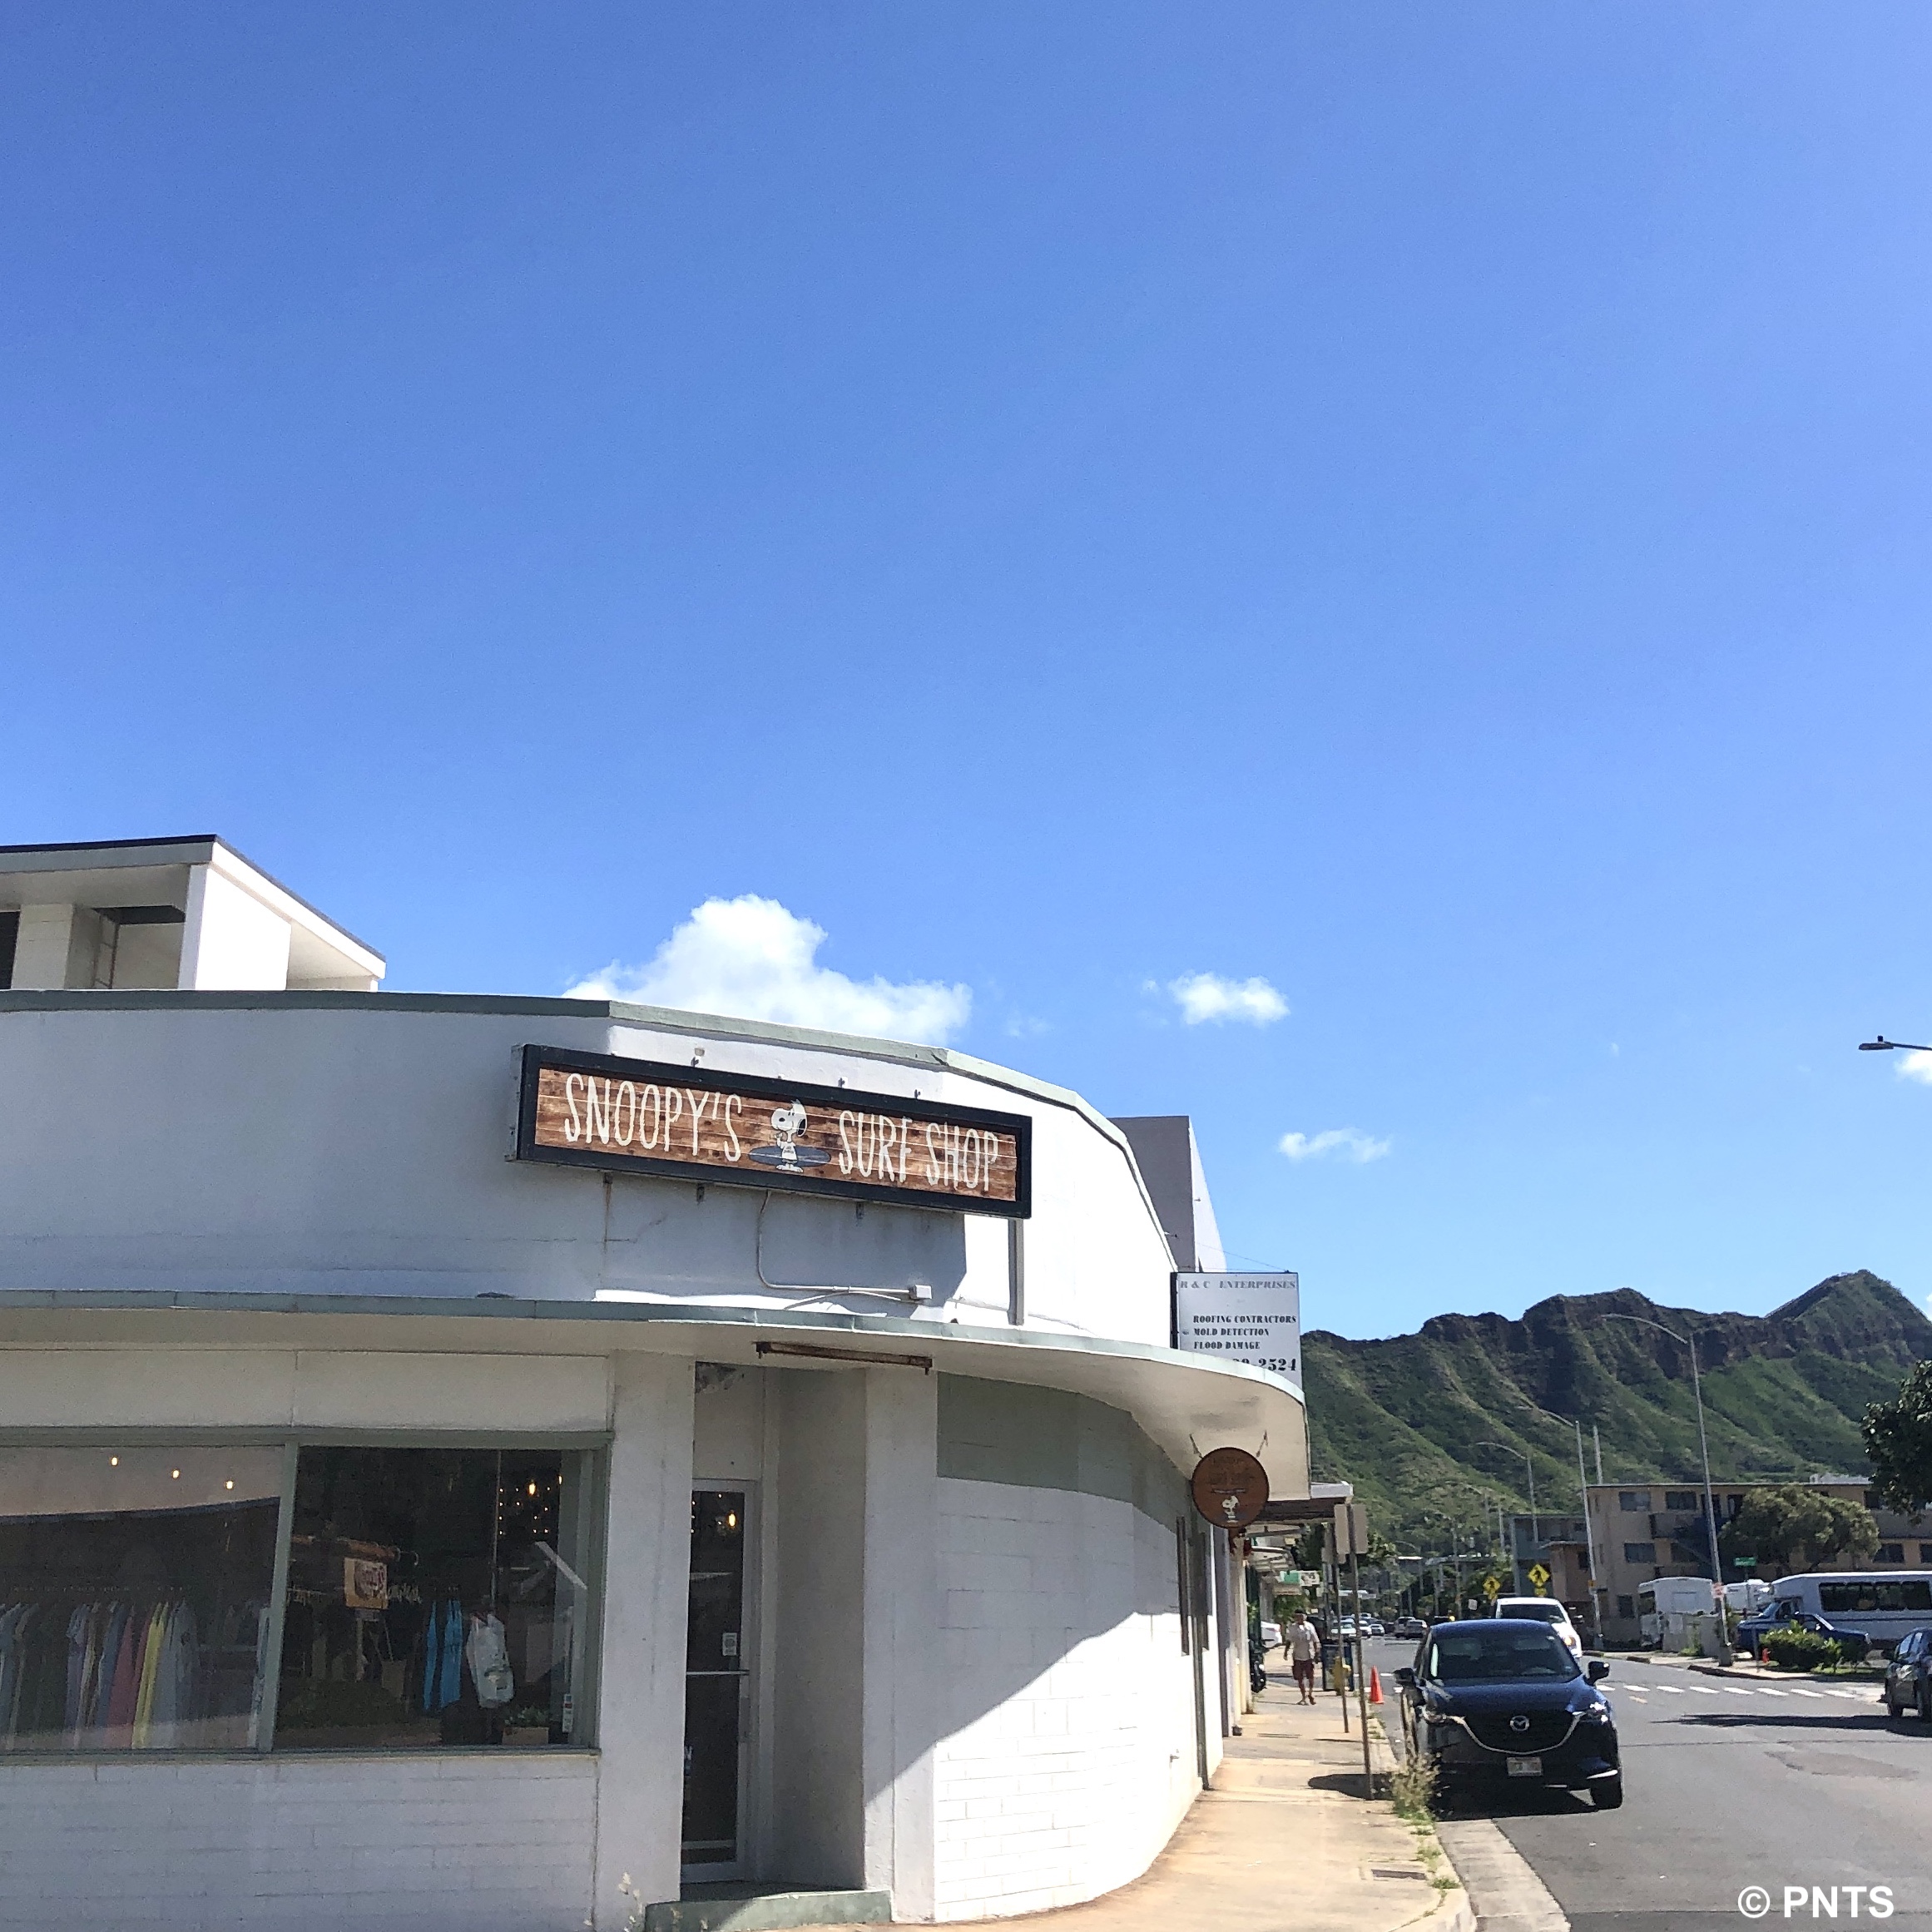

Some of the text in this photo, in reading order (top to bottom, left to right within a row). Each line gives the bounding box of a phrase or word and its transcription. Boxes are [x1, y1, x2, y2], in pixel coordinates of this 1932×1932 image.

[563, 1073, 1000, 1191] SNOOPY'S SURF SHOP
[1191, 1281, 1200, 1289] &
[1219, 1281, 1296, 1289] ENTERPRISES
[1221, 1328, 1270, 1336] DETECTION
[1194, 1341, 1261, 1350] FLOOD DAMAGE
